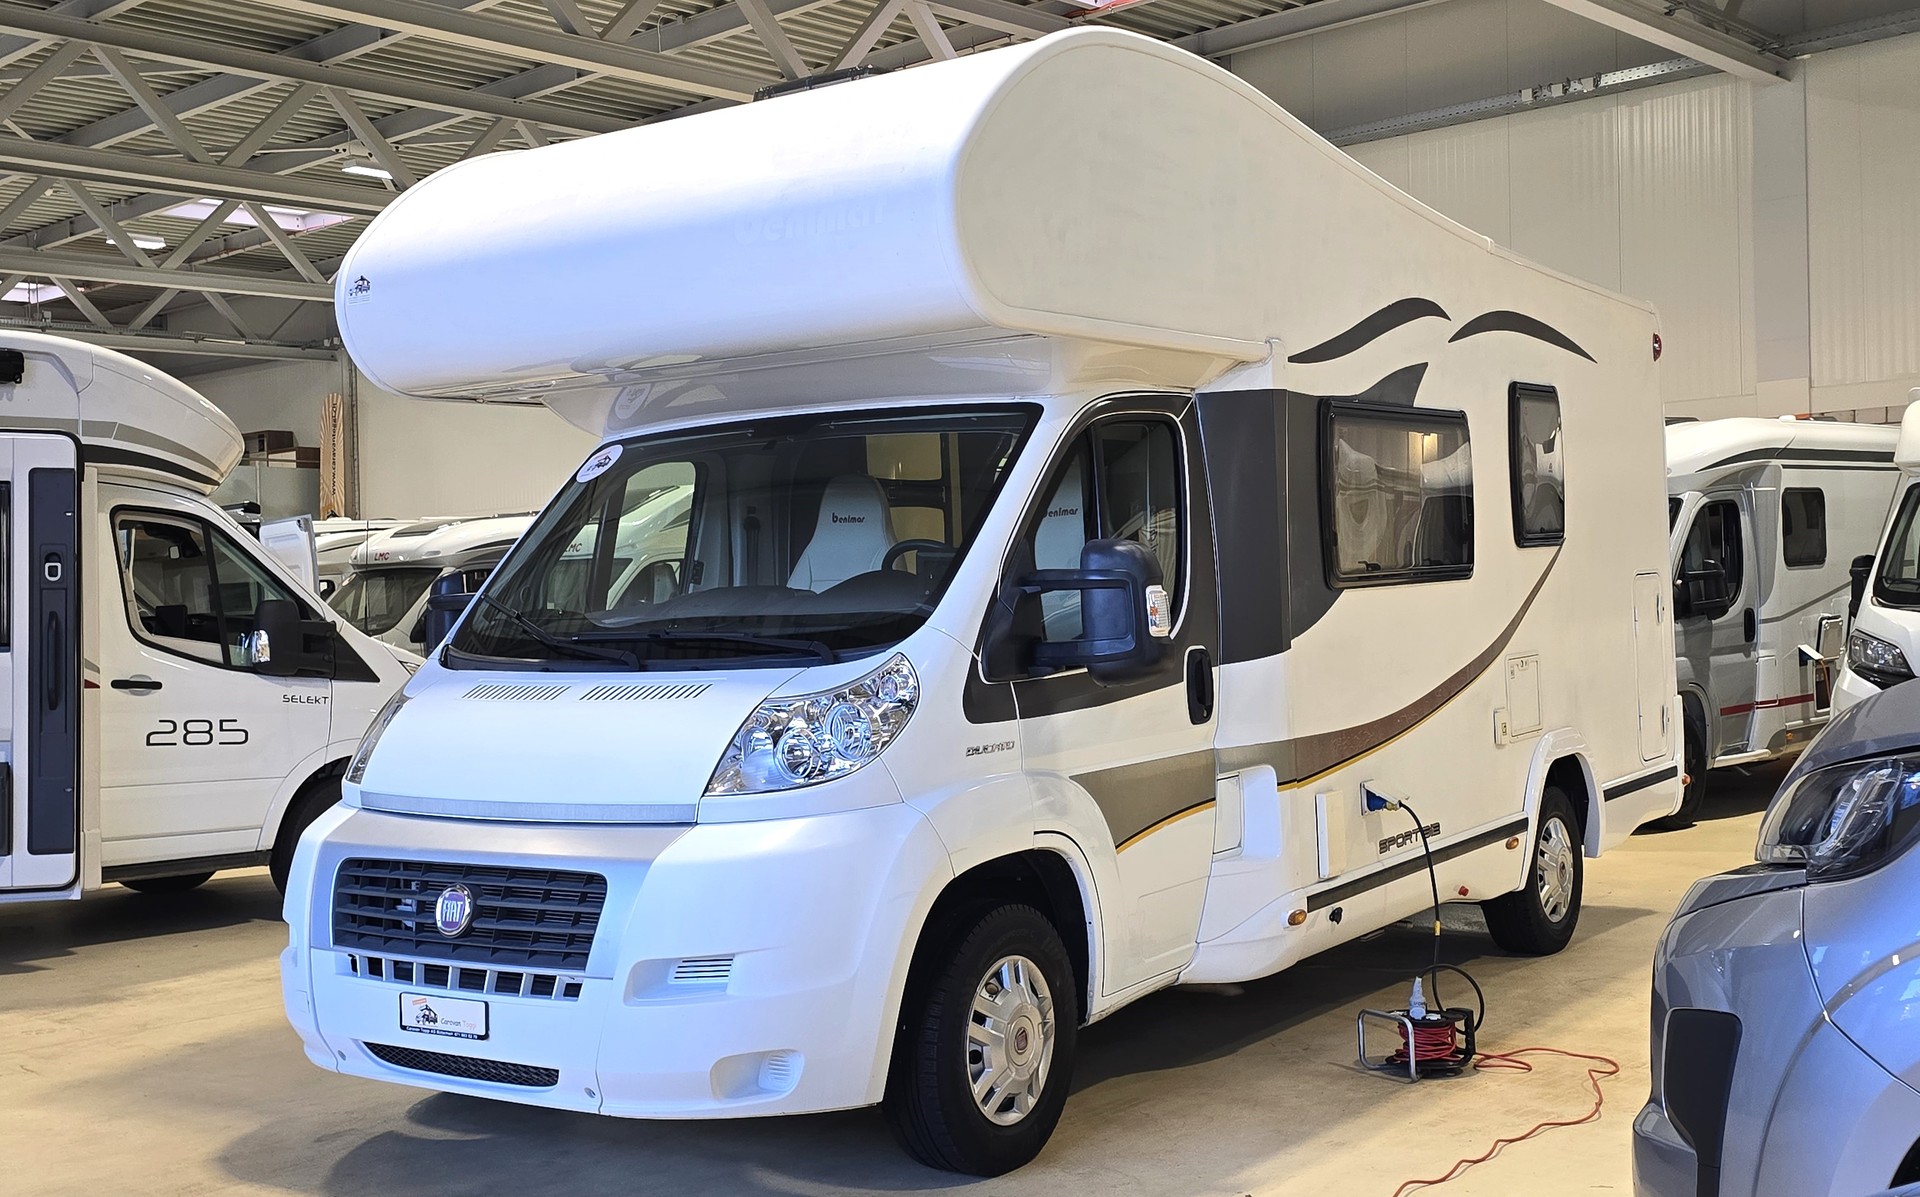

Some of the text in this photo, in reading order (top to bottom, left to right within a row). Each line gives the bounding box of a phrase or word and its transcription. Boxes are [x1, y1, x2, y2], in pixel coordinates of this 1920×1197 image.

[831, 512, 865, 524] benimar
[374, 552, 390, 561] LMC
[145, 719, 249, 747] 285
[1379, 827, 1421, 854] SPORT
[442, 900, 463, 922] FIAT
[440, 1017, 461, 1027] Caravan
